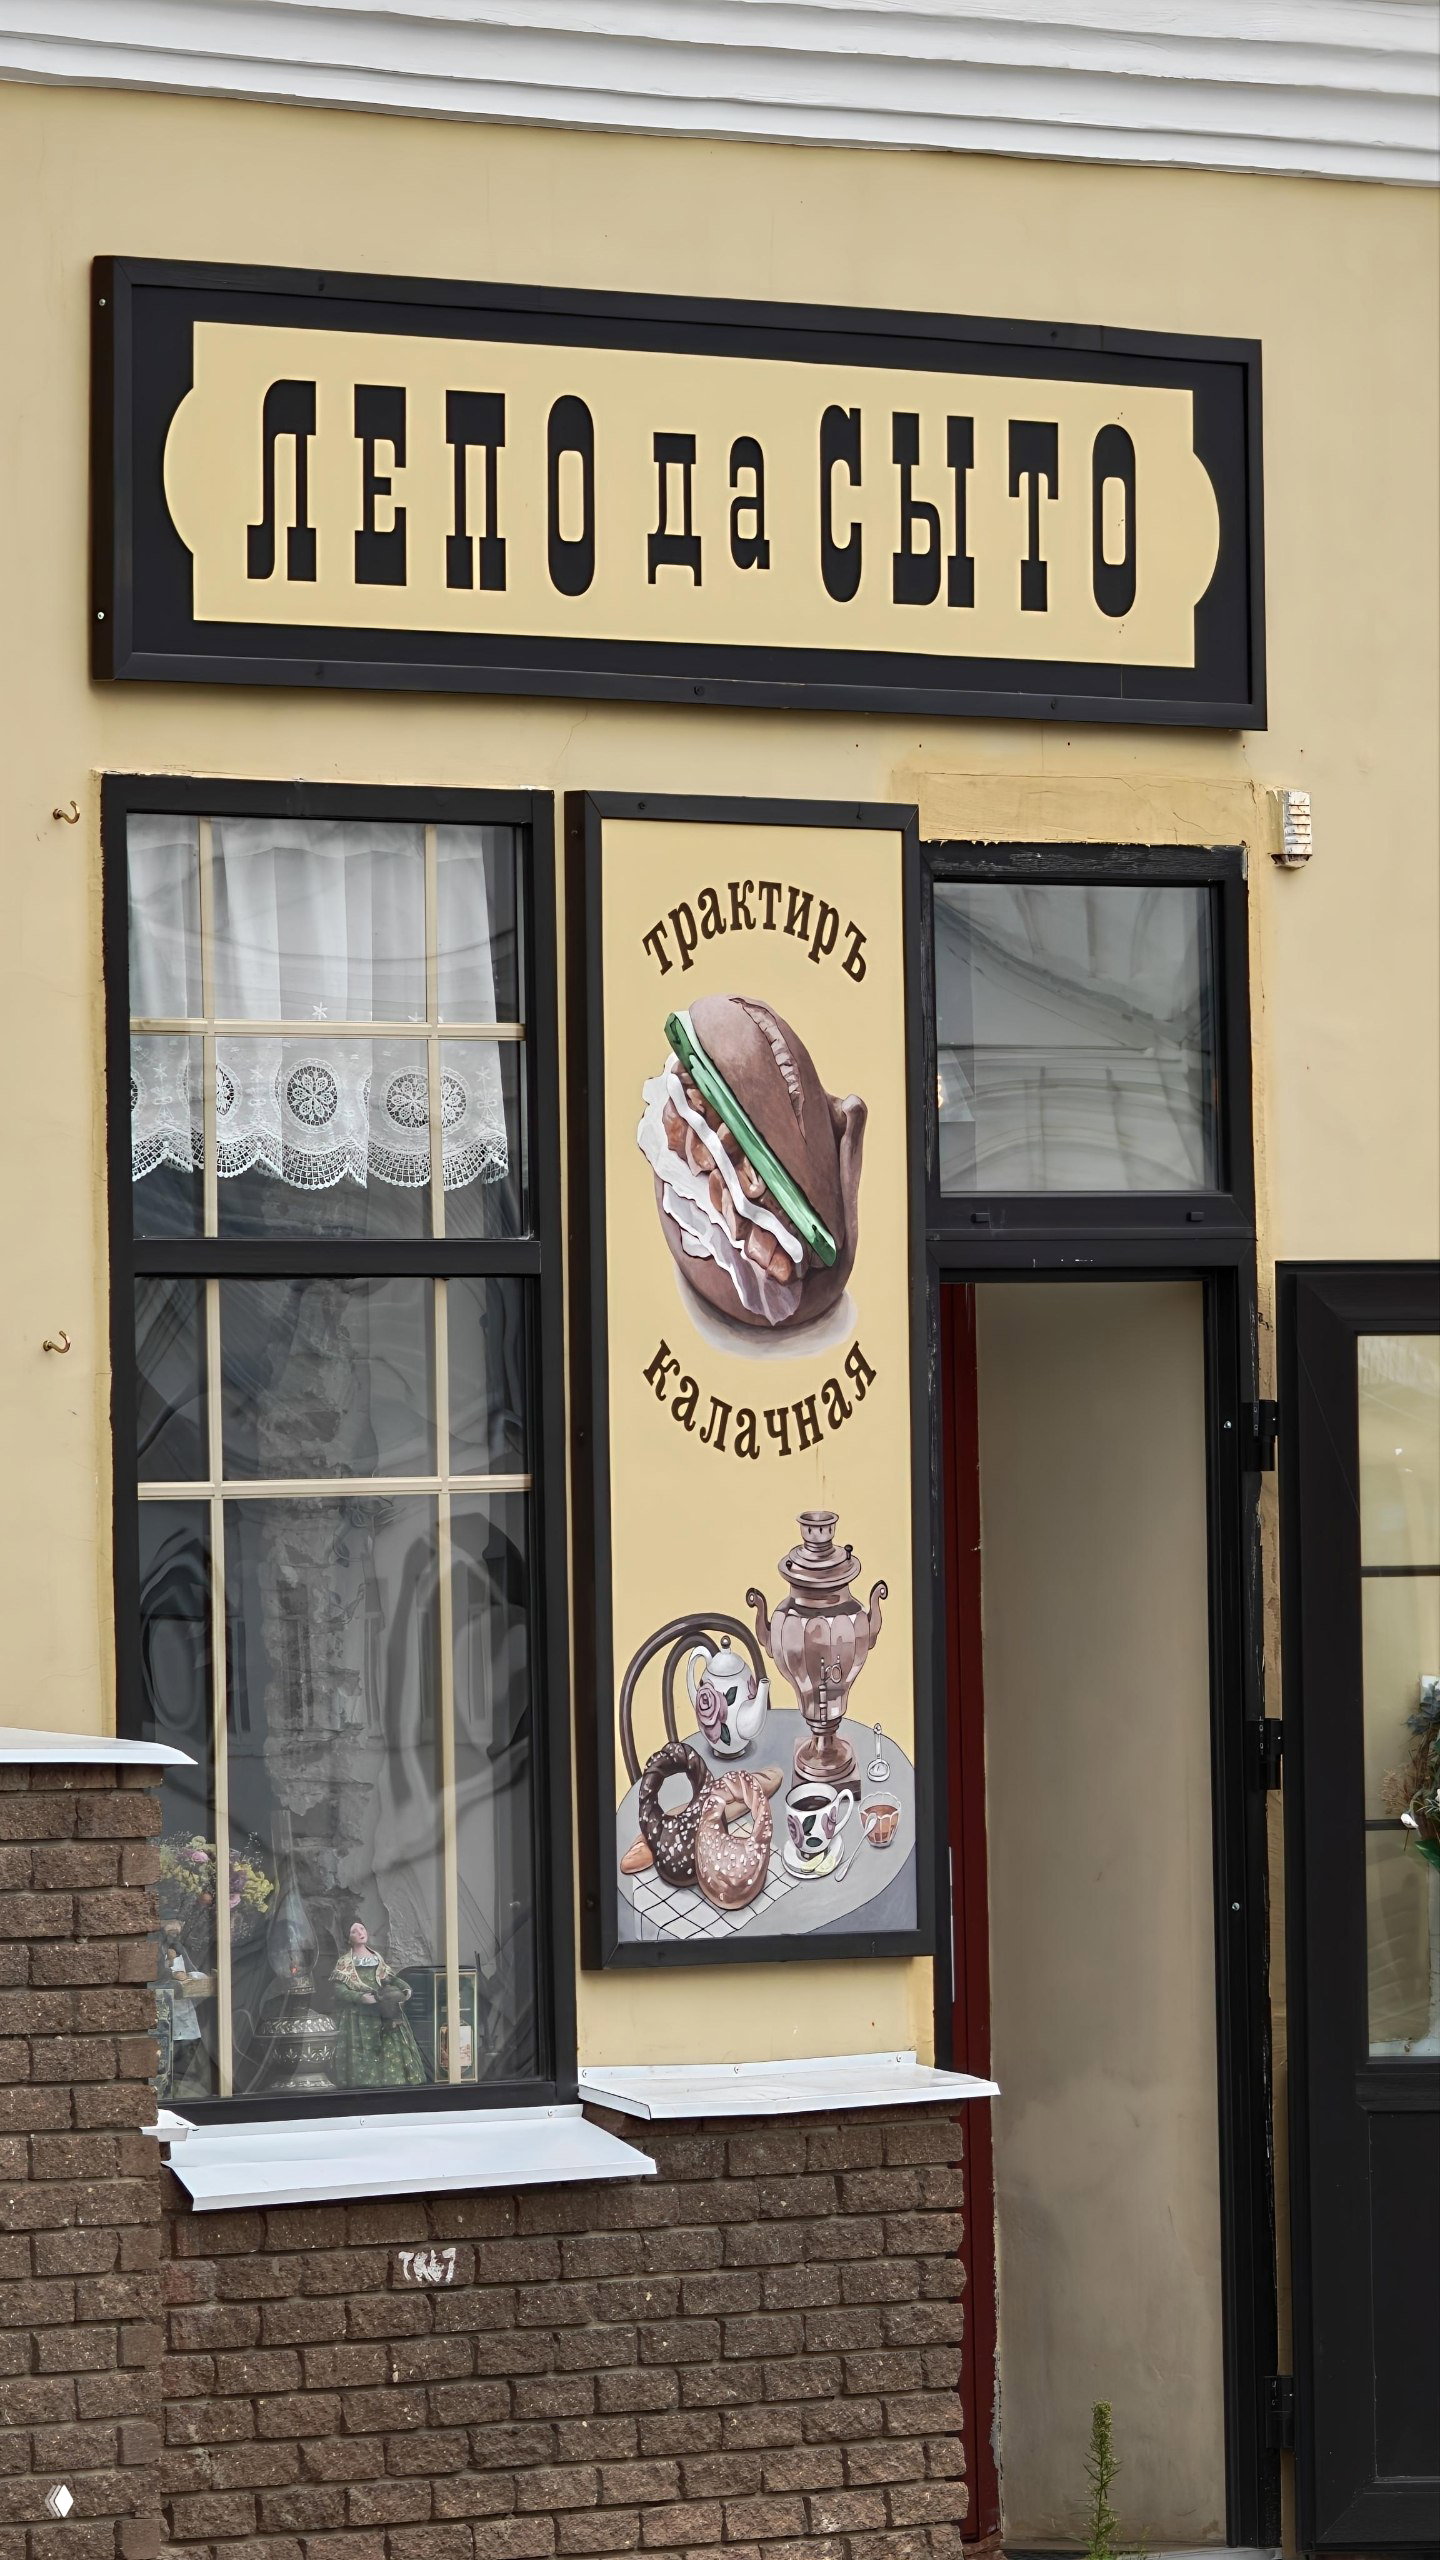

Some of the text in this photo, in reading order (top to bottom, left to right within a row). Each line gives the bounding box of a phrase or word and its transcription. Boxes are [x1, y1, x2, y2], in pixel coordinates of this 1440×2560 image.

[246, 378, 1137, 618] ЛЕПО да СЫТО
[642, 1338, 877, 1460] калачная
